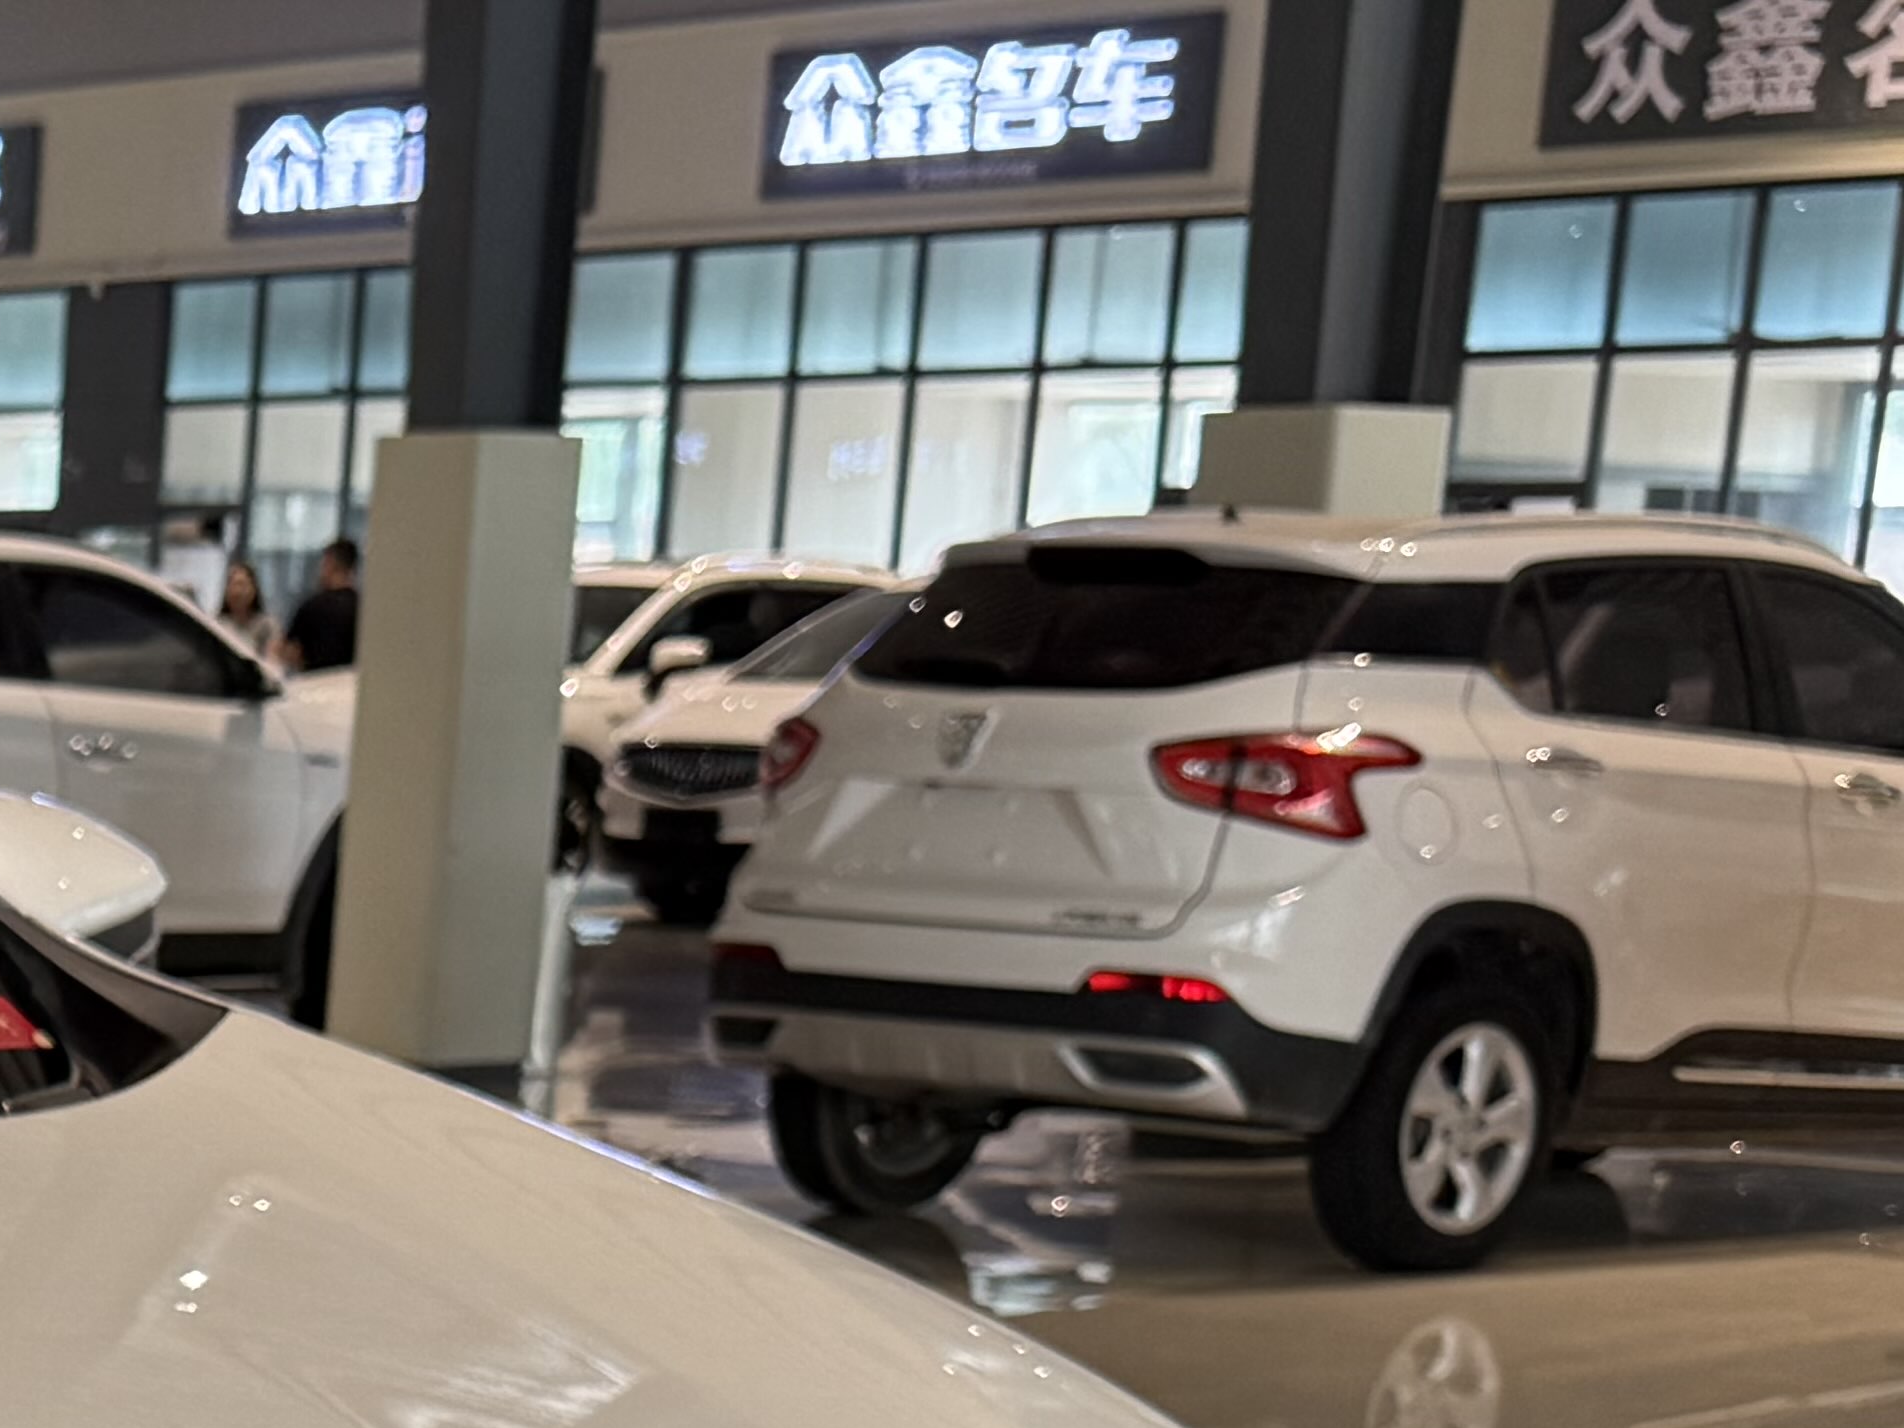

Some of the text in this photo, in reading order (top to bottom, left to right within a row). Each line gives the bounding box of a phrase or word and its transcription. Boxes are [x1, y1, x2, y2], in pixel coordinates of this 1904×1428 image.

[237, 104, 428, 216] 众鑫
[779, 28, 1181, 167] 众鑫名车
